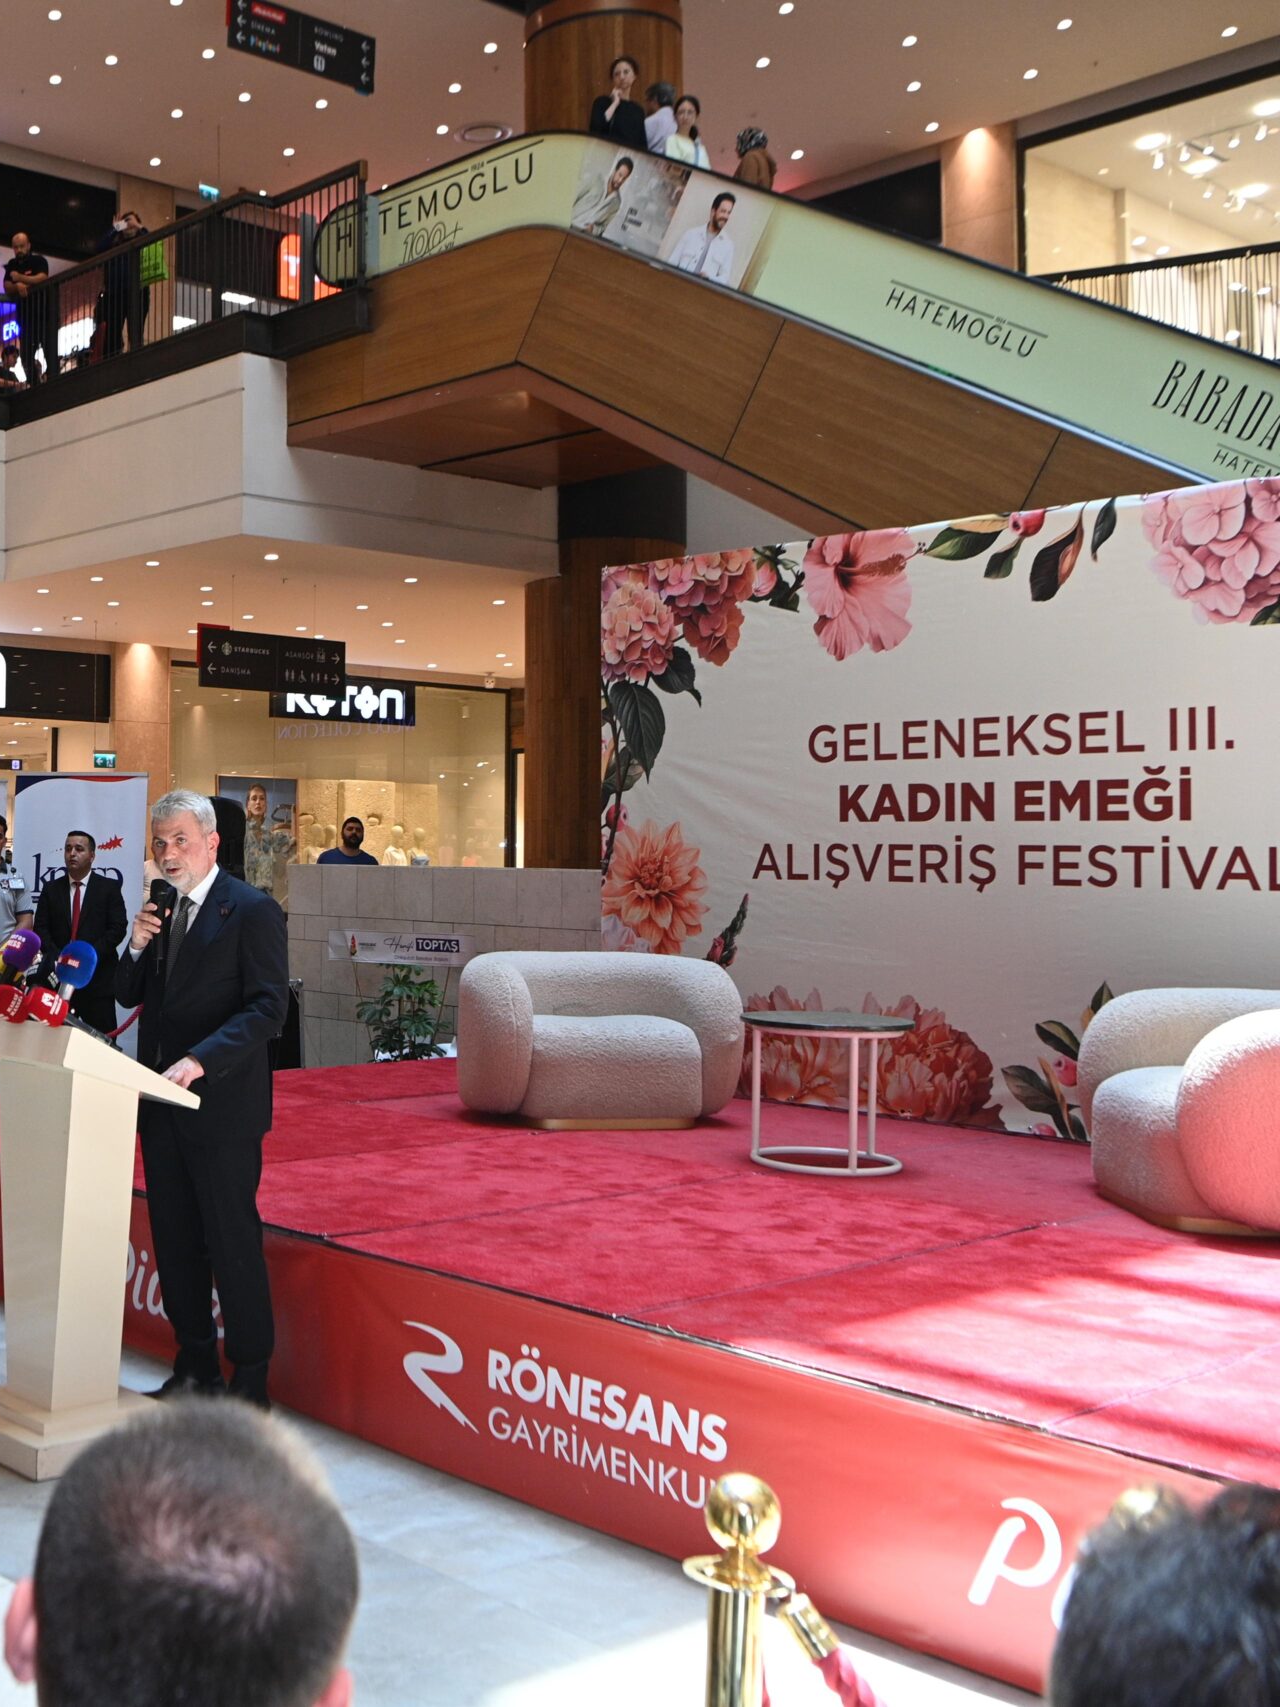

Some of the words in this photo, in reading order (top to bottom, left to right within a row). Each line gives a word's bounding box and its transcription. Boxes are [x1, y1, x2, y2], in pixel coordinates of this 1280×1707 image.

[807, 709, 1146, 763] GELENEKSEL
[838, 781, 995, 823] KADIN
[1014, 765, 1192, 822] EMEĞİ
[751, 835, 997, 893] ALIŞVERİŞ
[417, 939, 458, 952] TOPTAŞ
[487, 1343, 728, 1462] RÖNESANS
[488, 1406, 717, 1510] GAYRİMENKU
